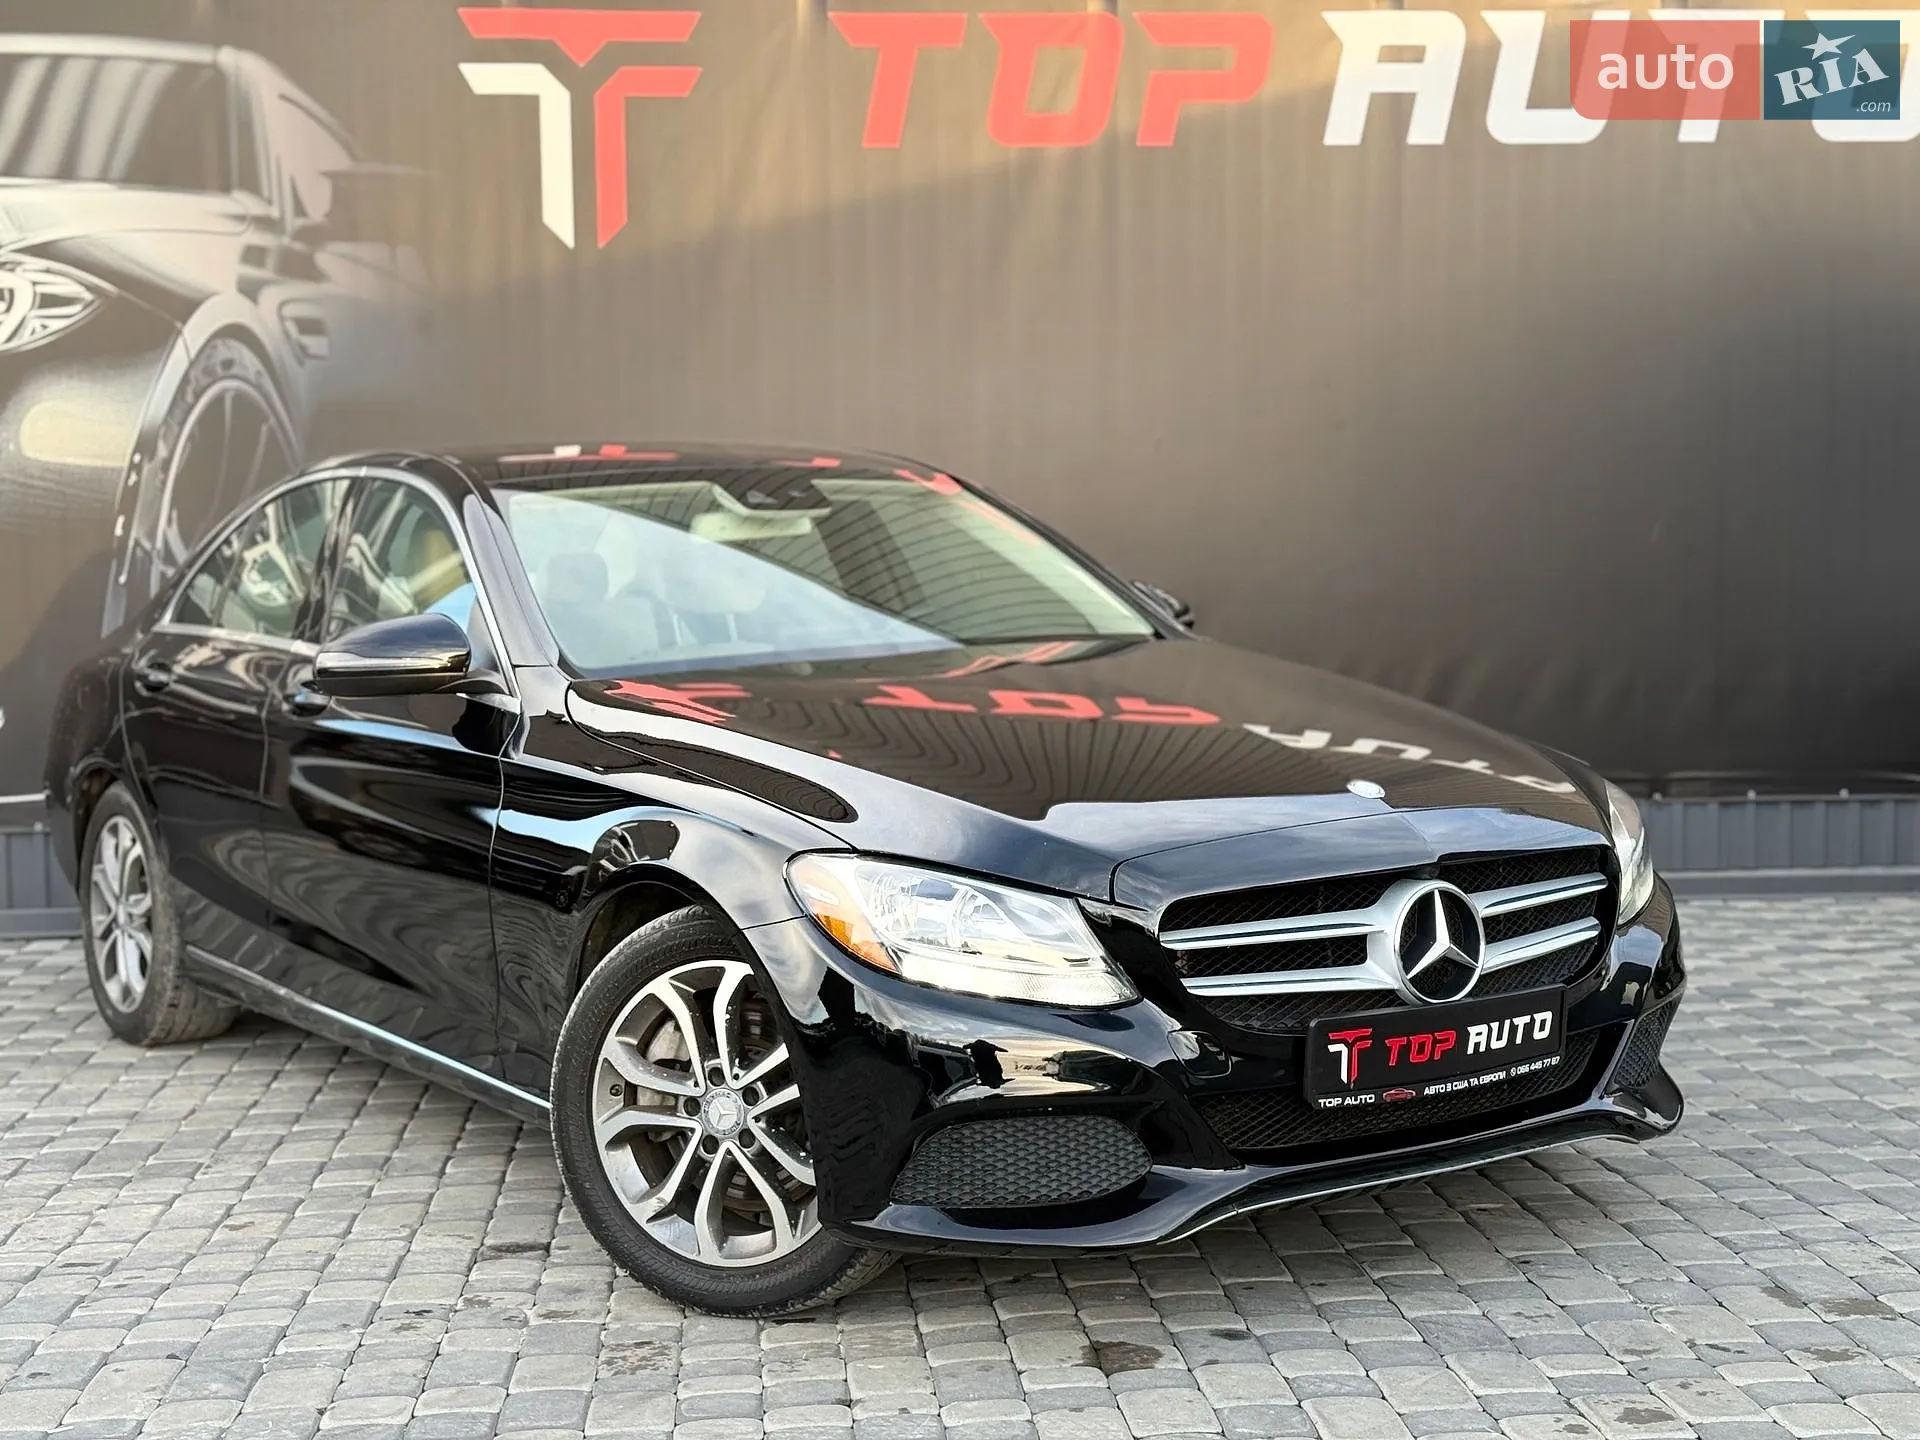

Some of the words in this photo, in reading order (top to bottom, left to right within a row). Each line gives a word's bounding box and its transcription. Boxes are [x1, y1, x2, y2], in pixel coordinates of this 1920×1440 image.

[828, 11, 1276, 149] TOP
[1384, 1029, 1457, 1067] TOP
[1466, 1010, 1553, 1055] AUTO
[1318, 1097, 1343, 1108] TOP
[1344, 1094, 1375, 1106] AUTO
